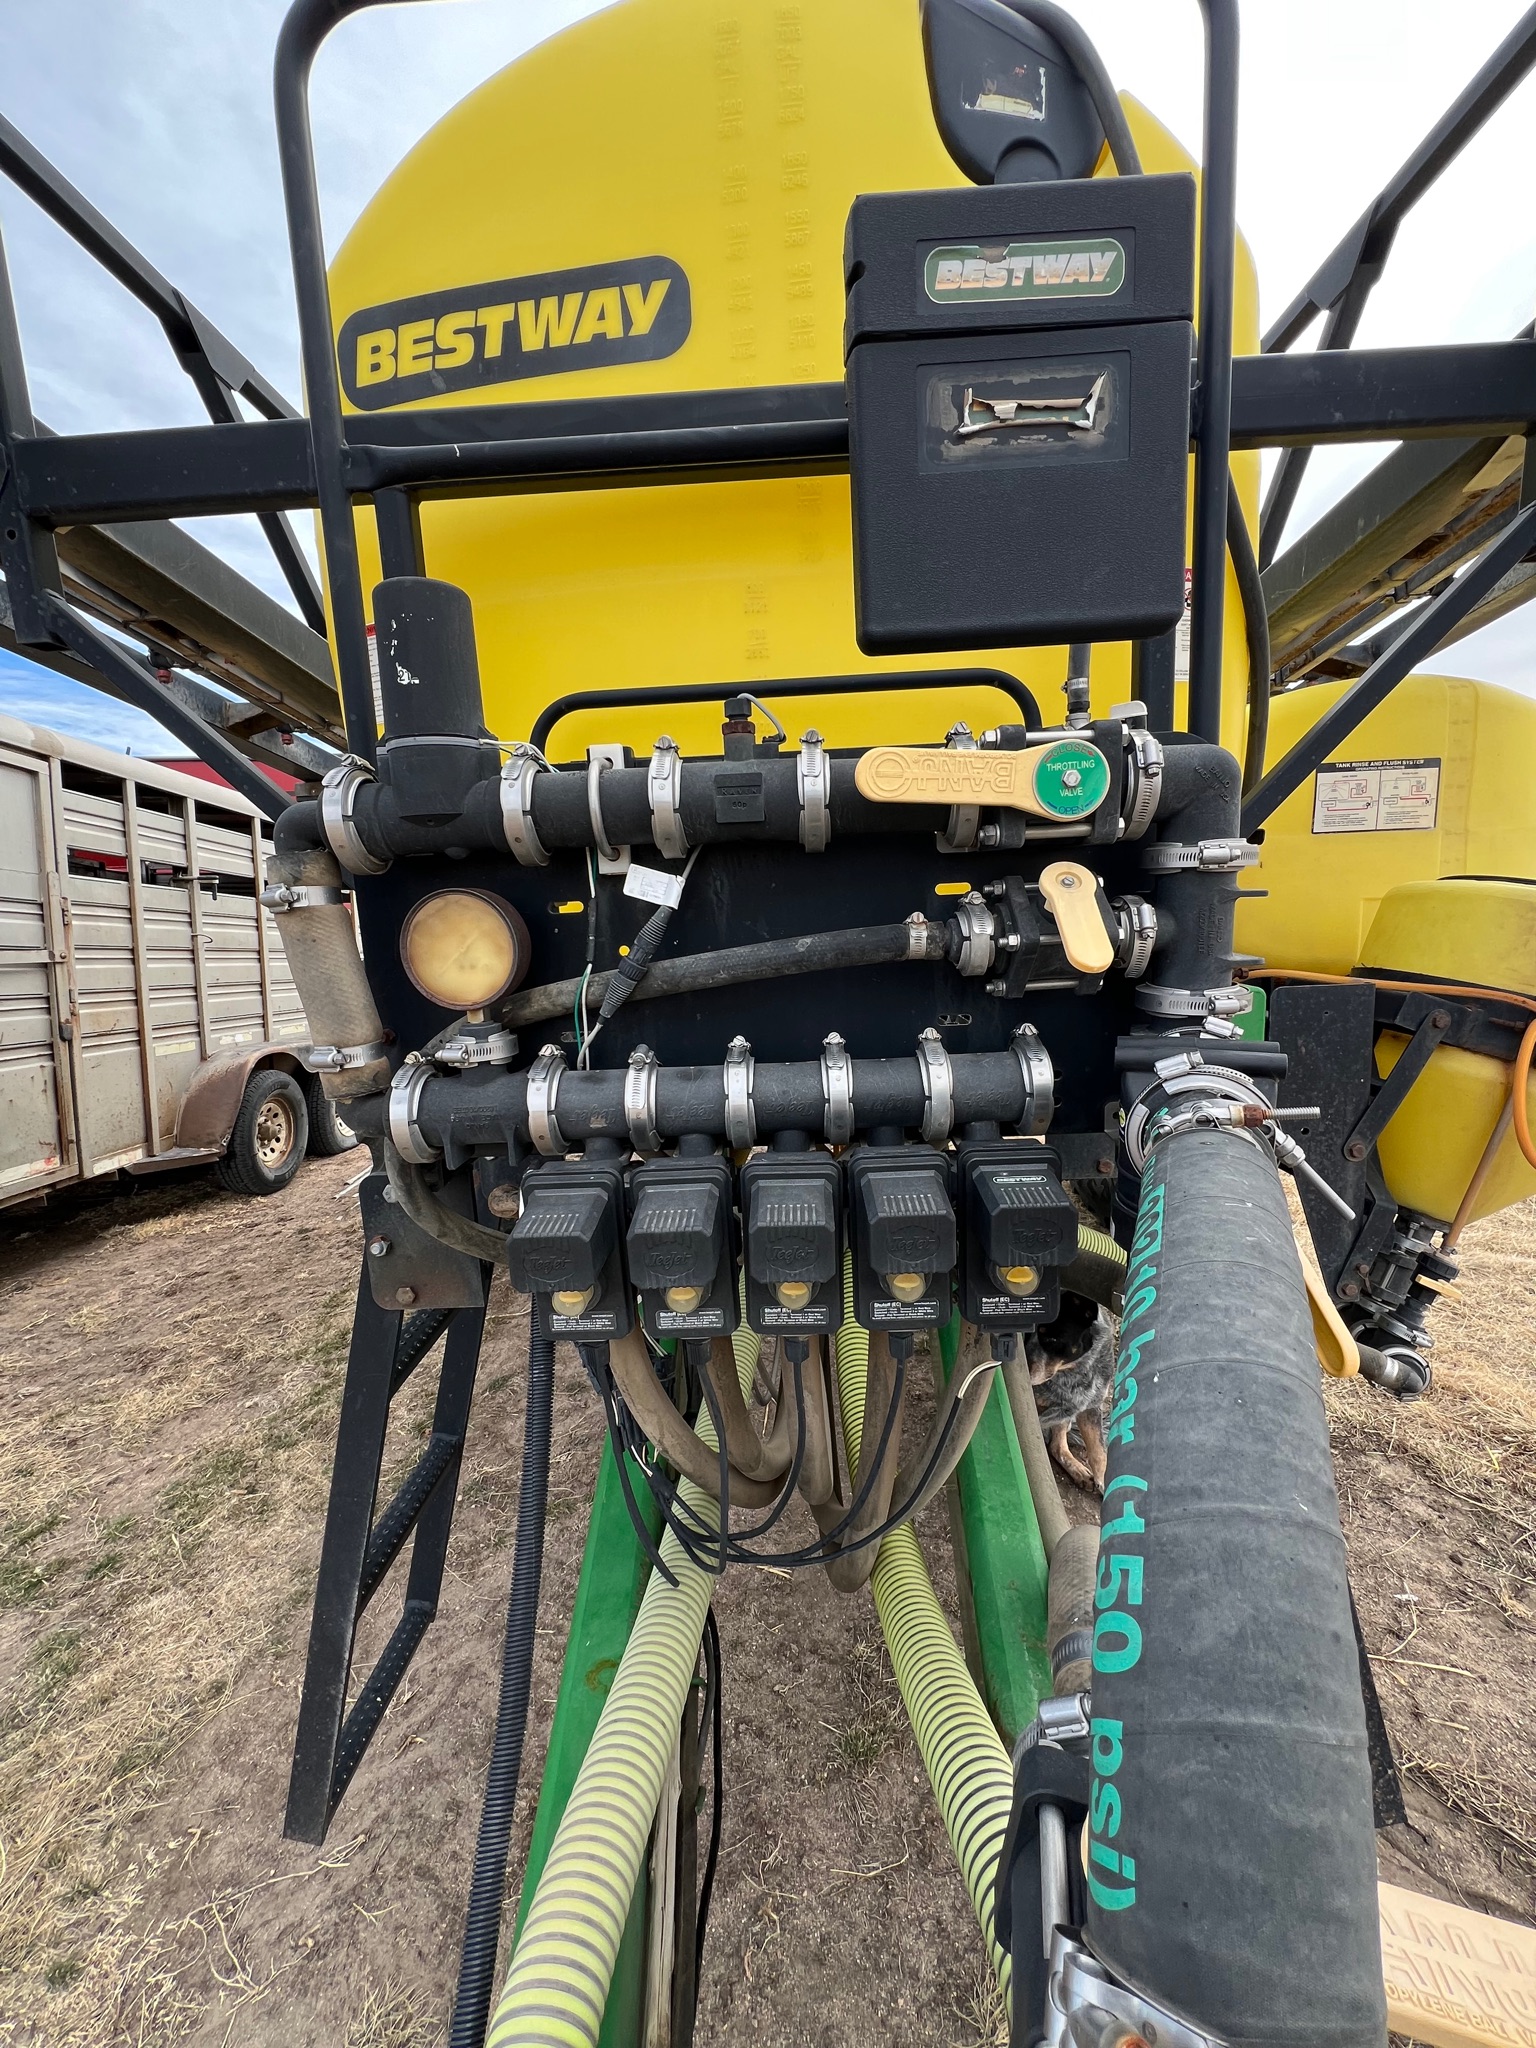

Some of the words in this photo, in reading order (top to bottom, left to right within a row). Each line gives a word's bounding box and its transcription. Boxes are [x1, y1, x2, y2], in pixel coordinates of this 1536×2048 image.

[935, 252, 1117, 290] BESTWAY
[356, 279, 671, 388] BESTWAY
[1051, 743, 1088, 757] CLOSE
[1046, 759, 1095, 771] THROTTLING
[721, 787, 757, 796] RAVEN
[1059, 787, 1084, 797] VALVE
[1058, 804, 1085, 815] OPEN
[892, 1235, 936, 1255] TeeJet
[1011, 1228, 1058, 1247] TeeJet
[528, 1255, 573, 1272] TeeJet
[650, 1251, 693, 1270] TeeJet
[770, 1245, 816, 1266] TeeJet
[1107, 1329, 1155, 1445] bar
[1092, 1474, 1148, 1674] (150
[1088, 1718, 1136, 1911] psi)
